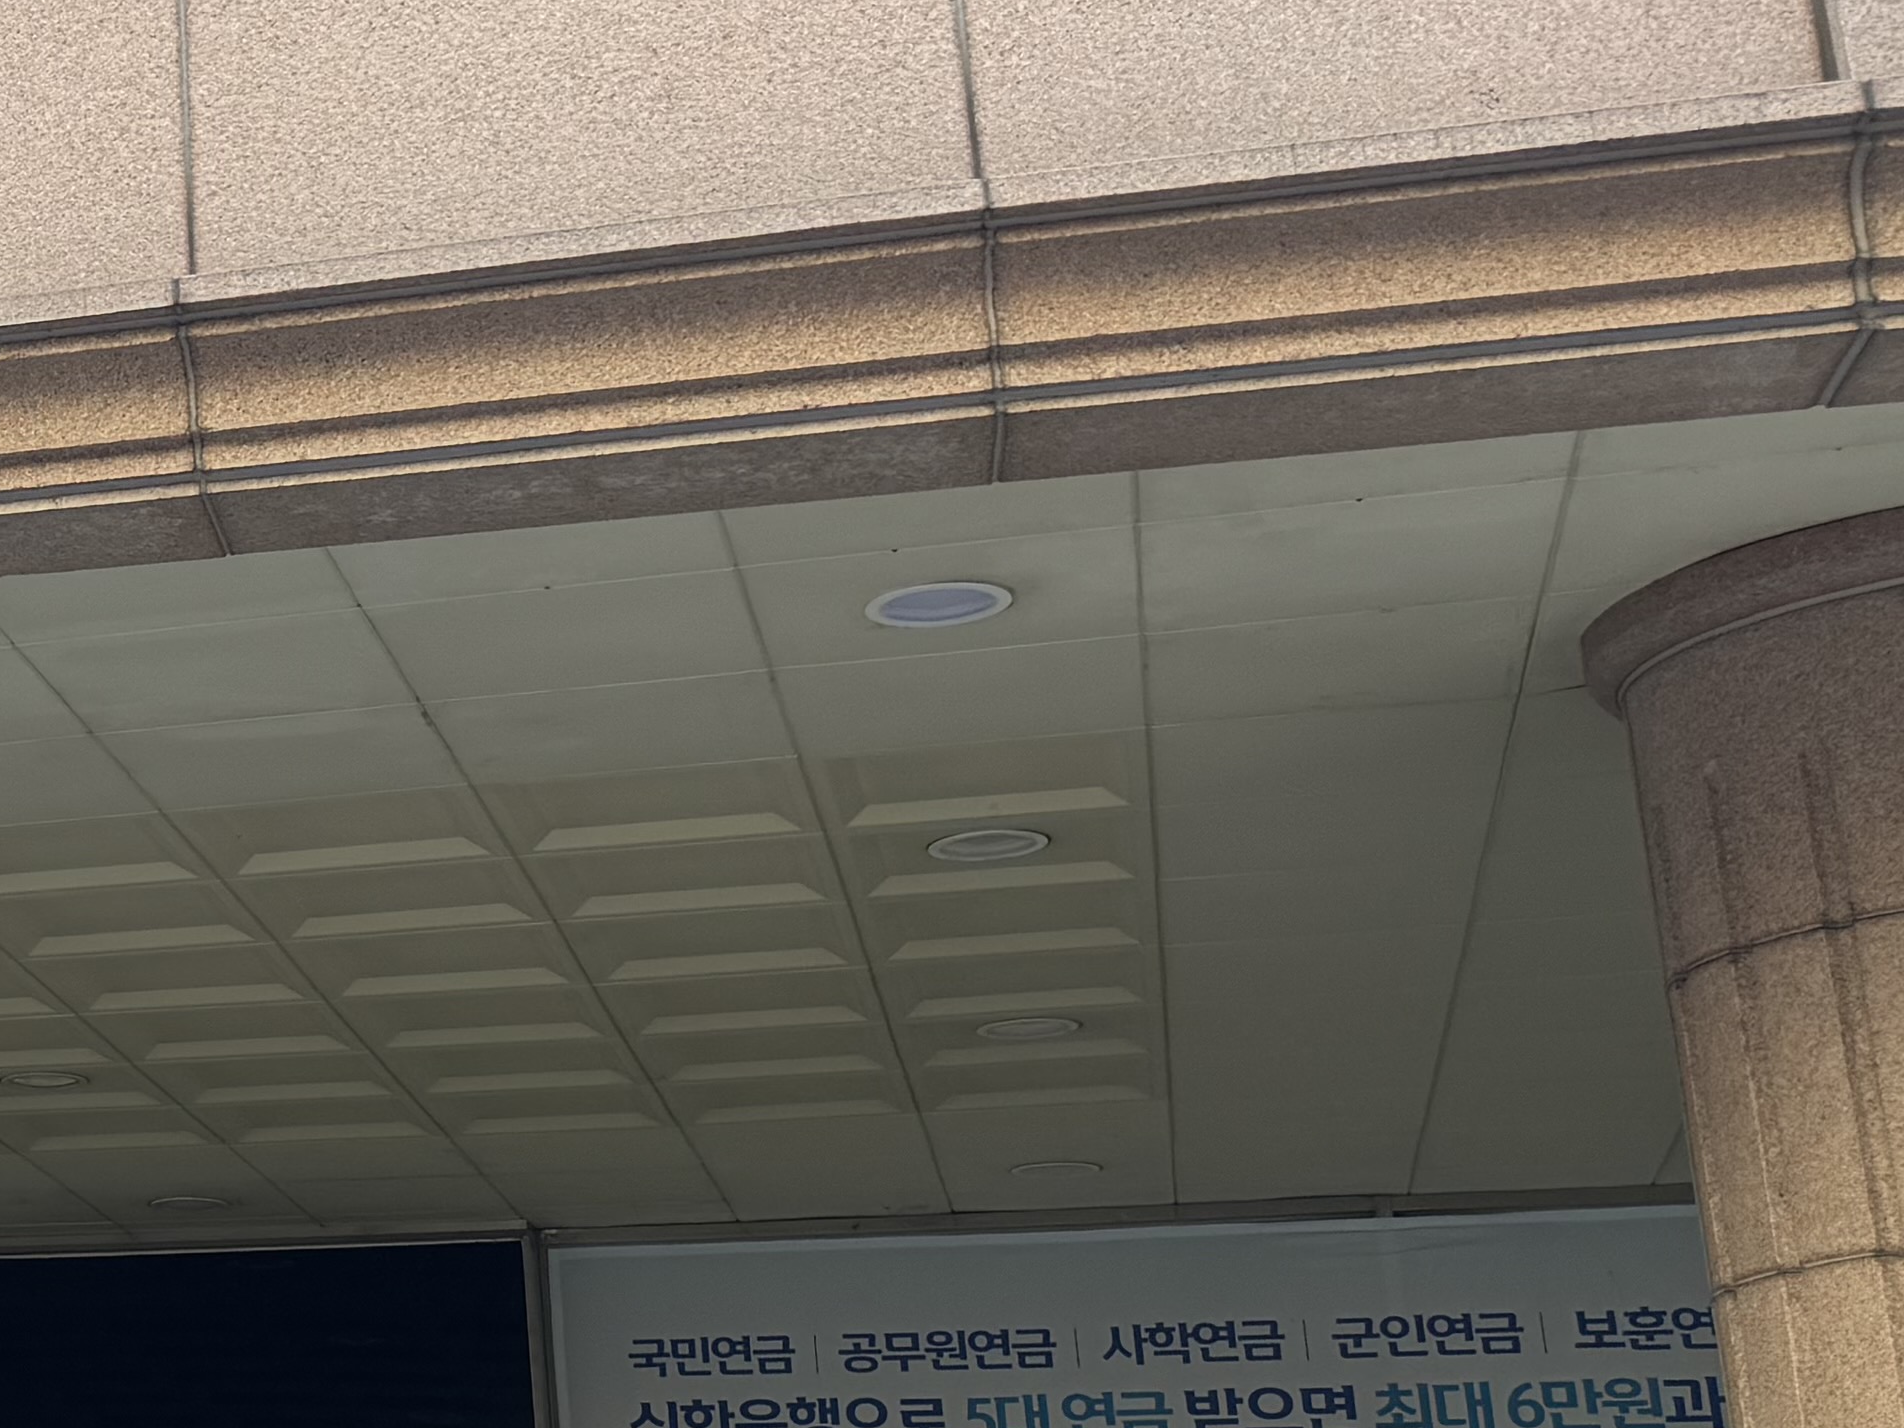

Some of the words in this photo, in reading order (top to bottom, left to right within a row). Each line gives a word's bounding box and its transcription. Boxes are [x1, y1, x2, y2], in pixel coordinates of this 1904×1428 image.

[628, 1335, 796, 1377] 국민연금
[837, 1328, 1058, 1372] 공무원연금
[1102, 1320, 1285, 1365] 사학연금
[1331, 1311, 1524, 1360] 군인연금
